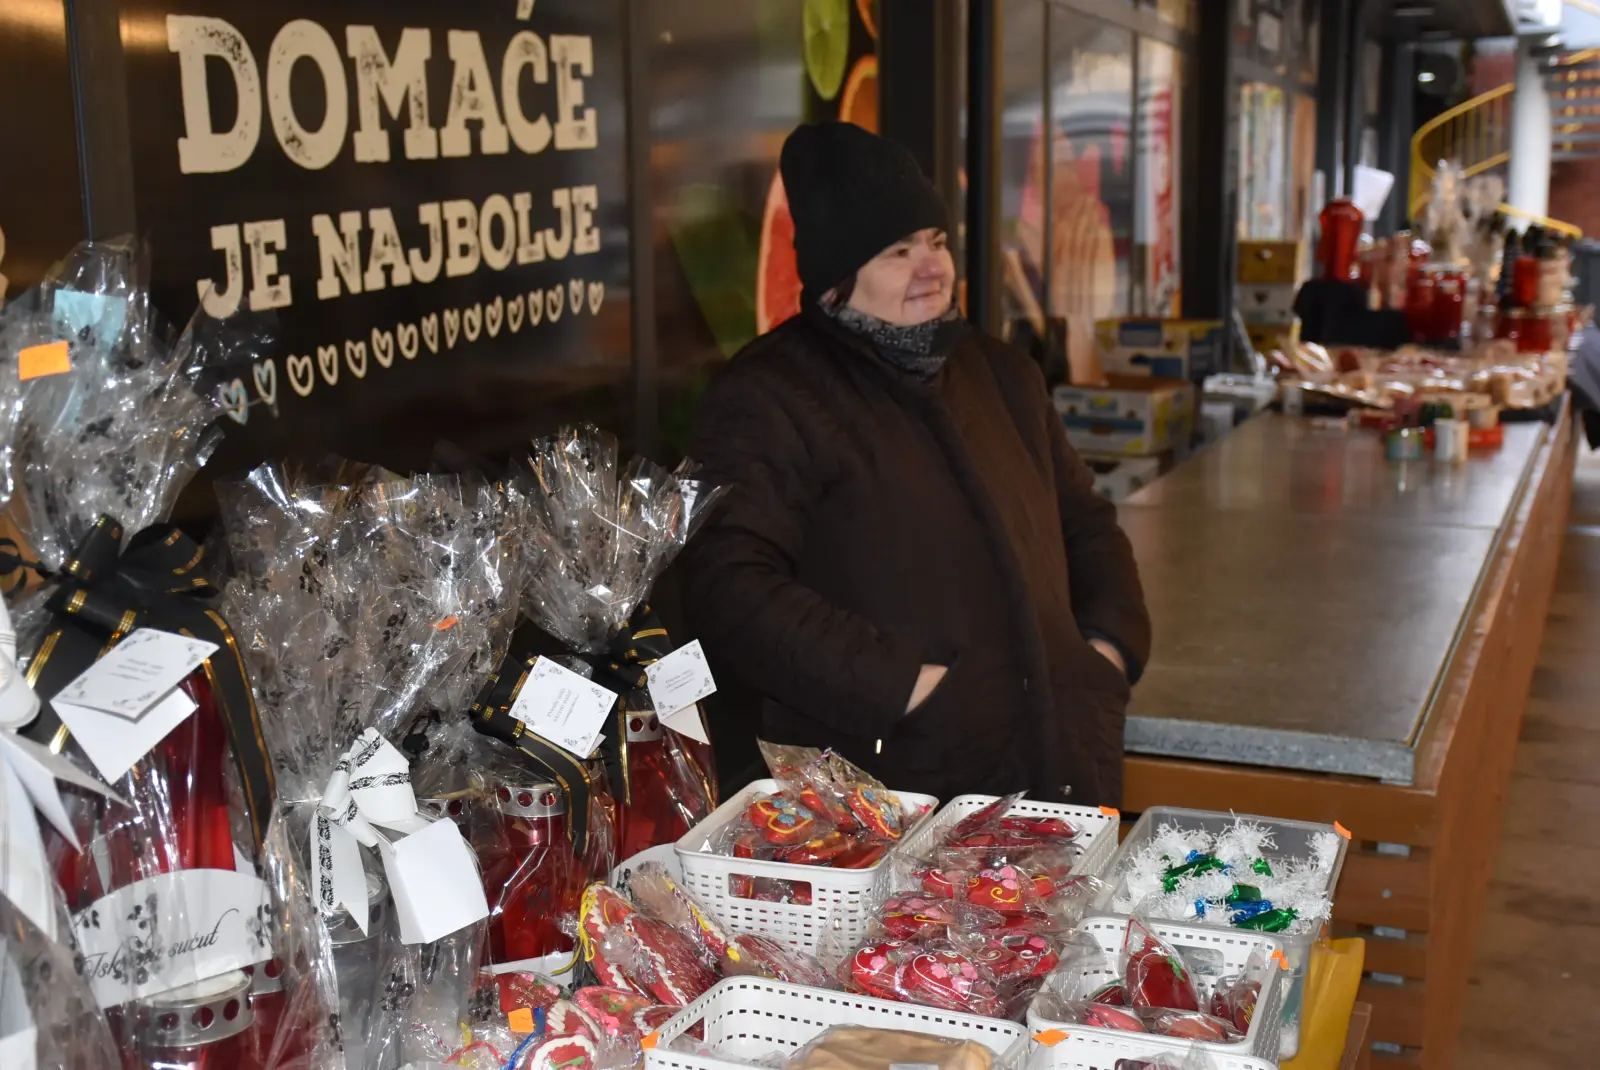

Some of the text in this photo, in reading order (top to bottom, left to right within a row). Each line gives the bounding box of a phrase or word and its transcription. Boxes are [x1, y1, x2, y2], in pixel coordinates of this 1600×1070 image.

[166, 0, 597, 174] DOMAĆE
[197, 186, 600, 319] JE NAJBOLJE
[170, 908, 240, 957] sućut
